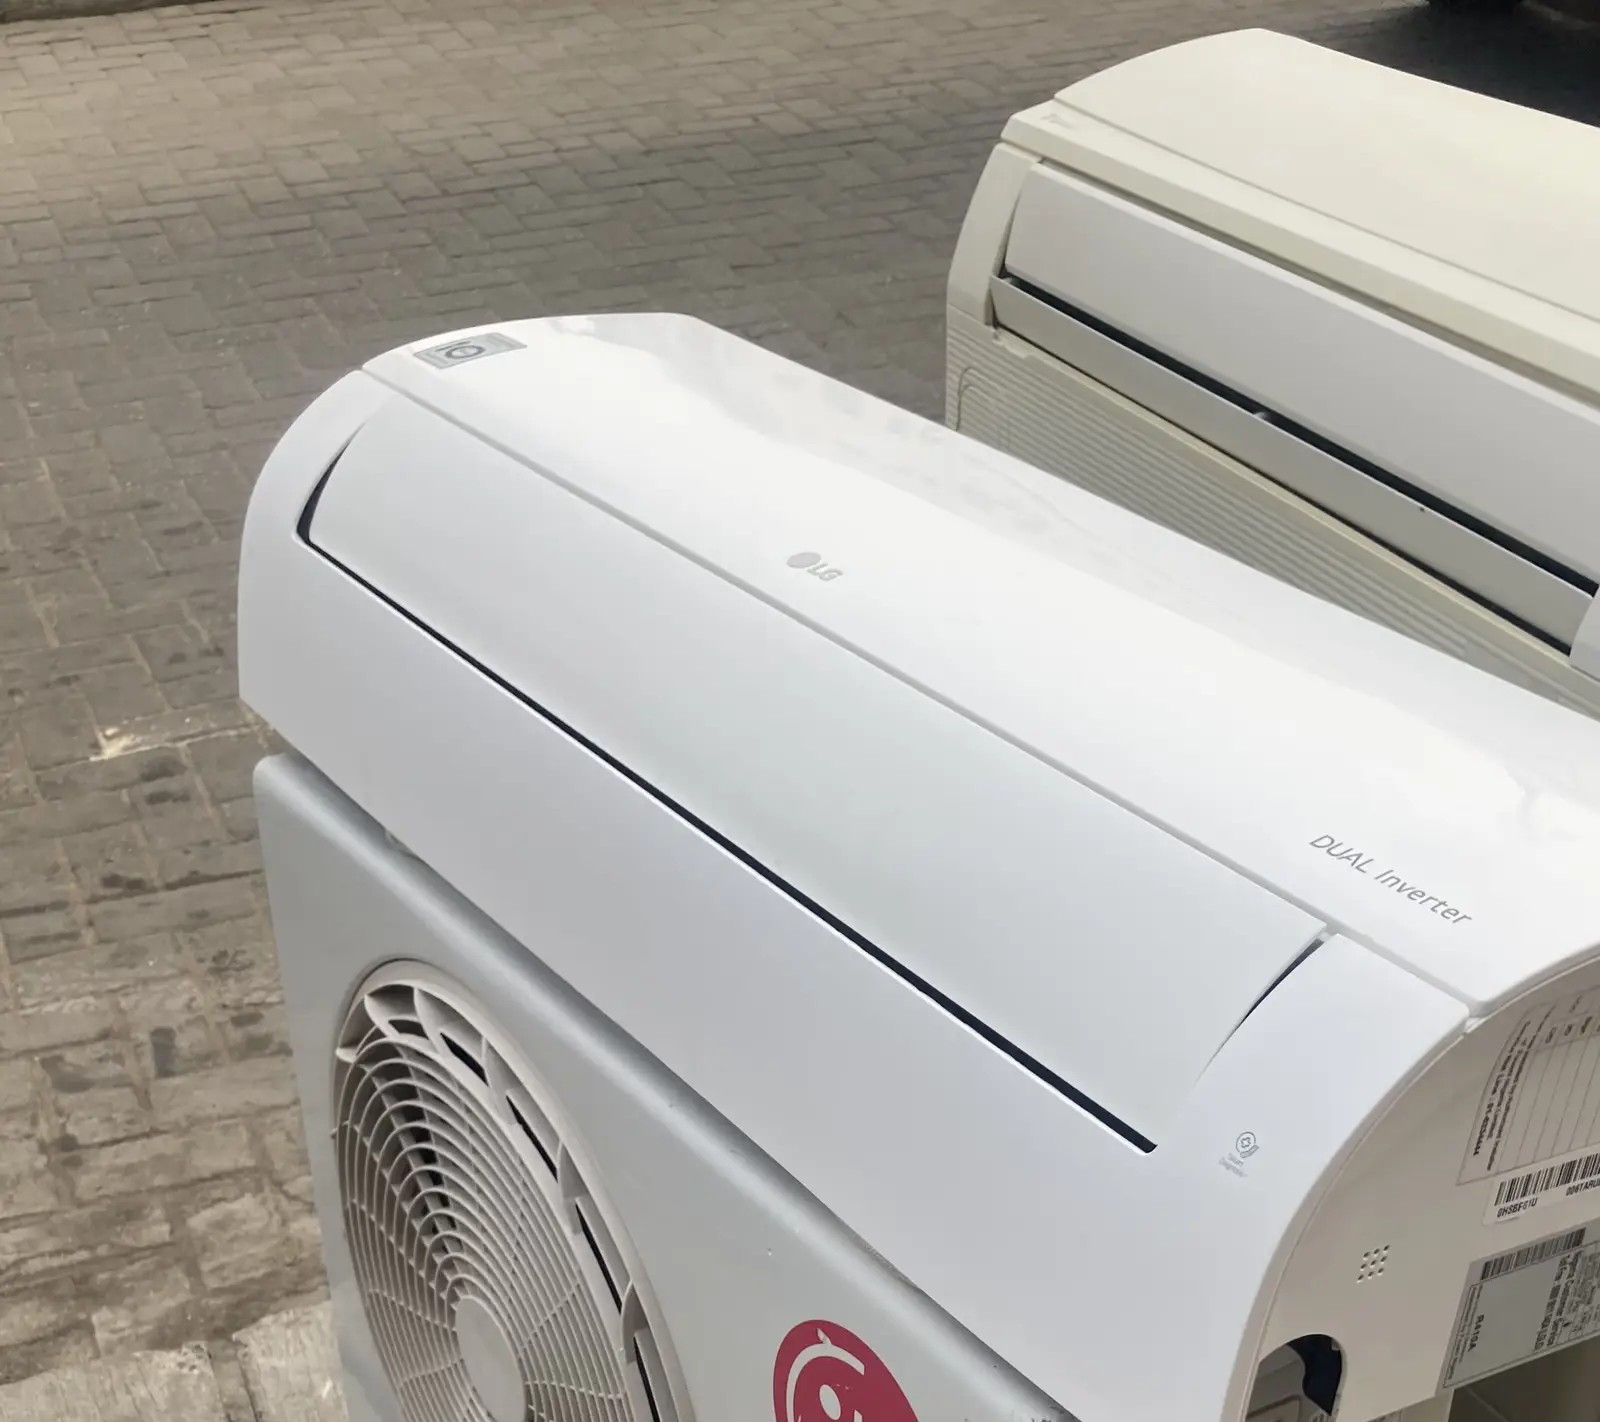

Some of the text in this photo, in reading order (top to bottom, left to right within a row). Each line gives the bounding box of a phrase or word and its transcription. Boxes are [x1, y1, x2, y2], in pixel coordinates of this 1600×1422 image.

[1308, 834, 1472, 923] DUAL Inverter
[1468, 1314, 1485, 1352] R410A
